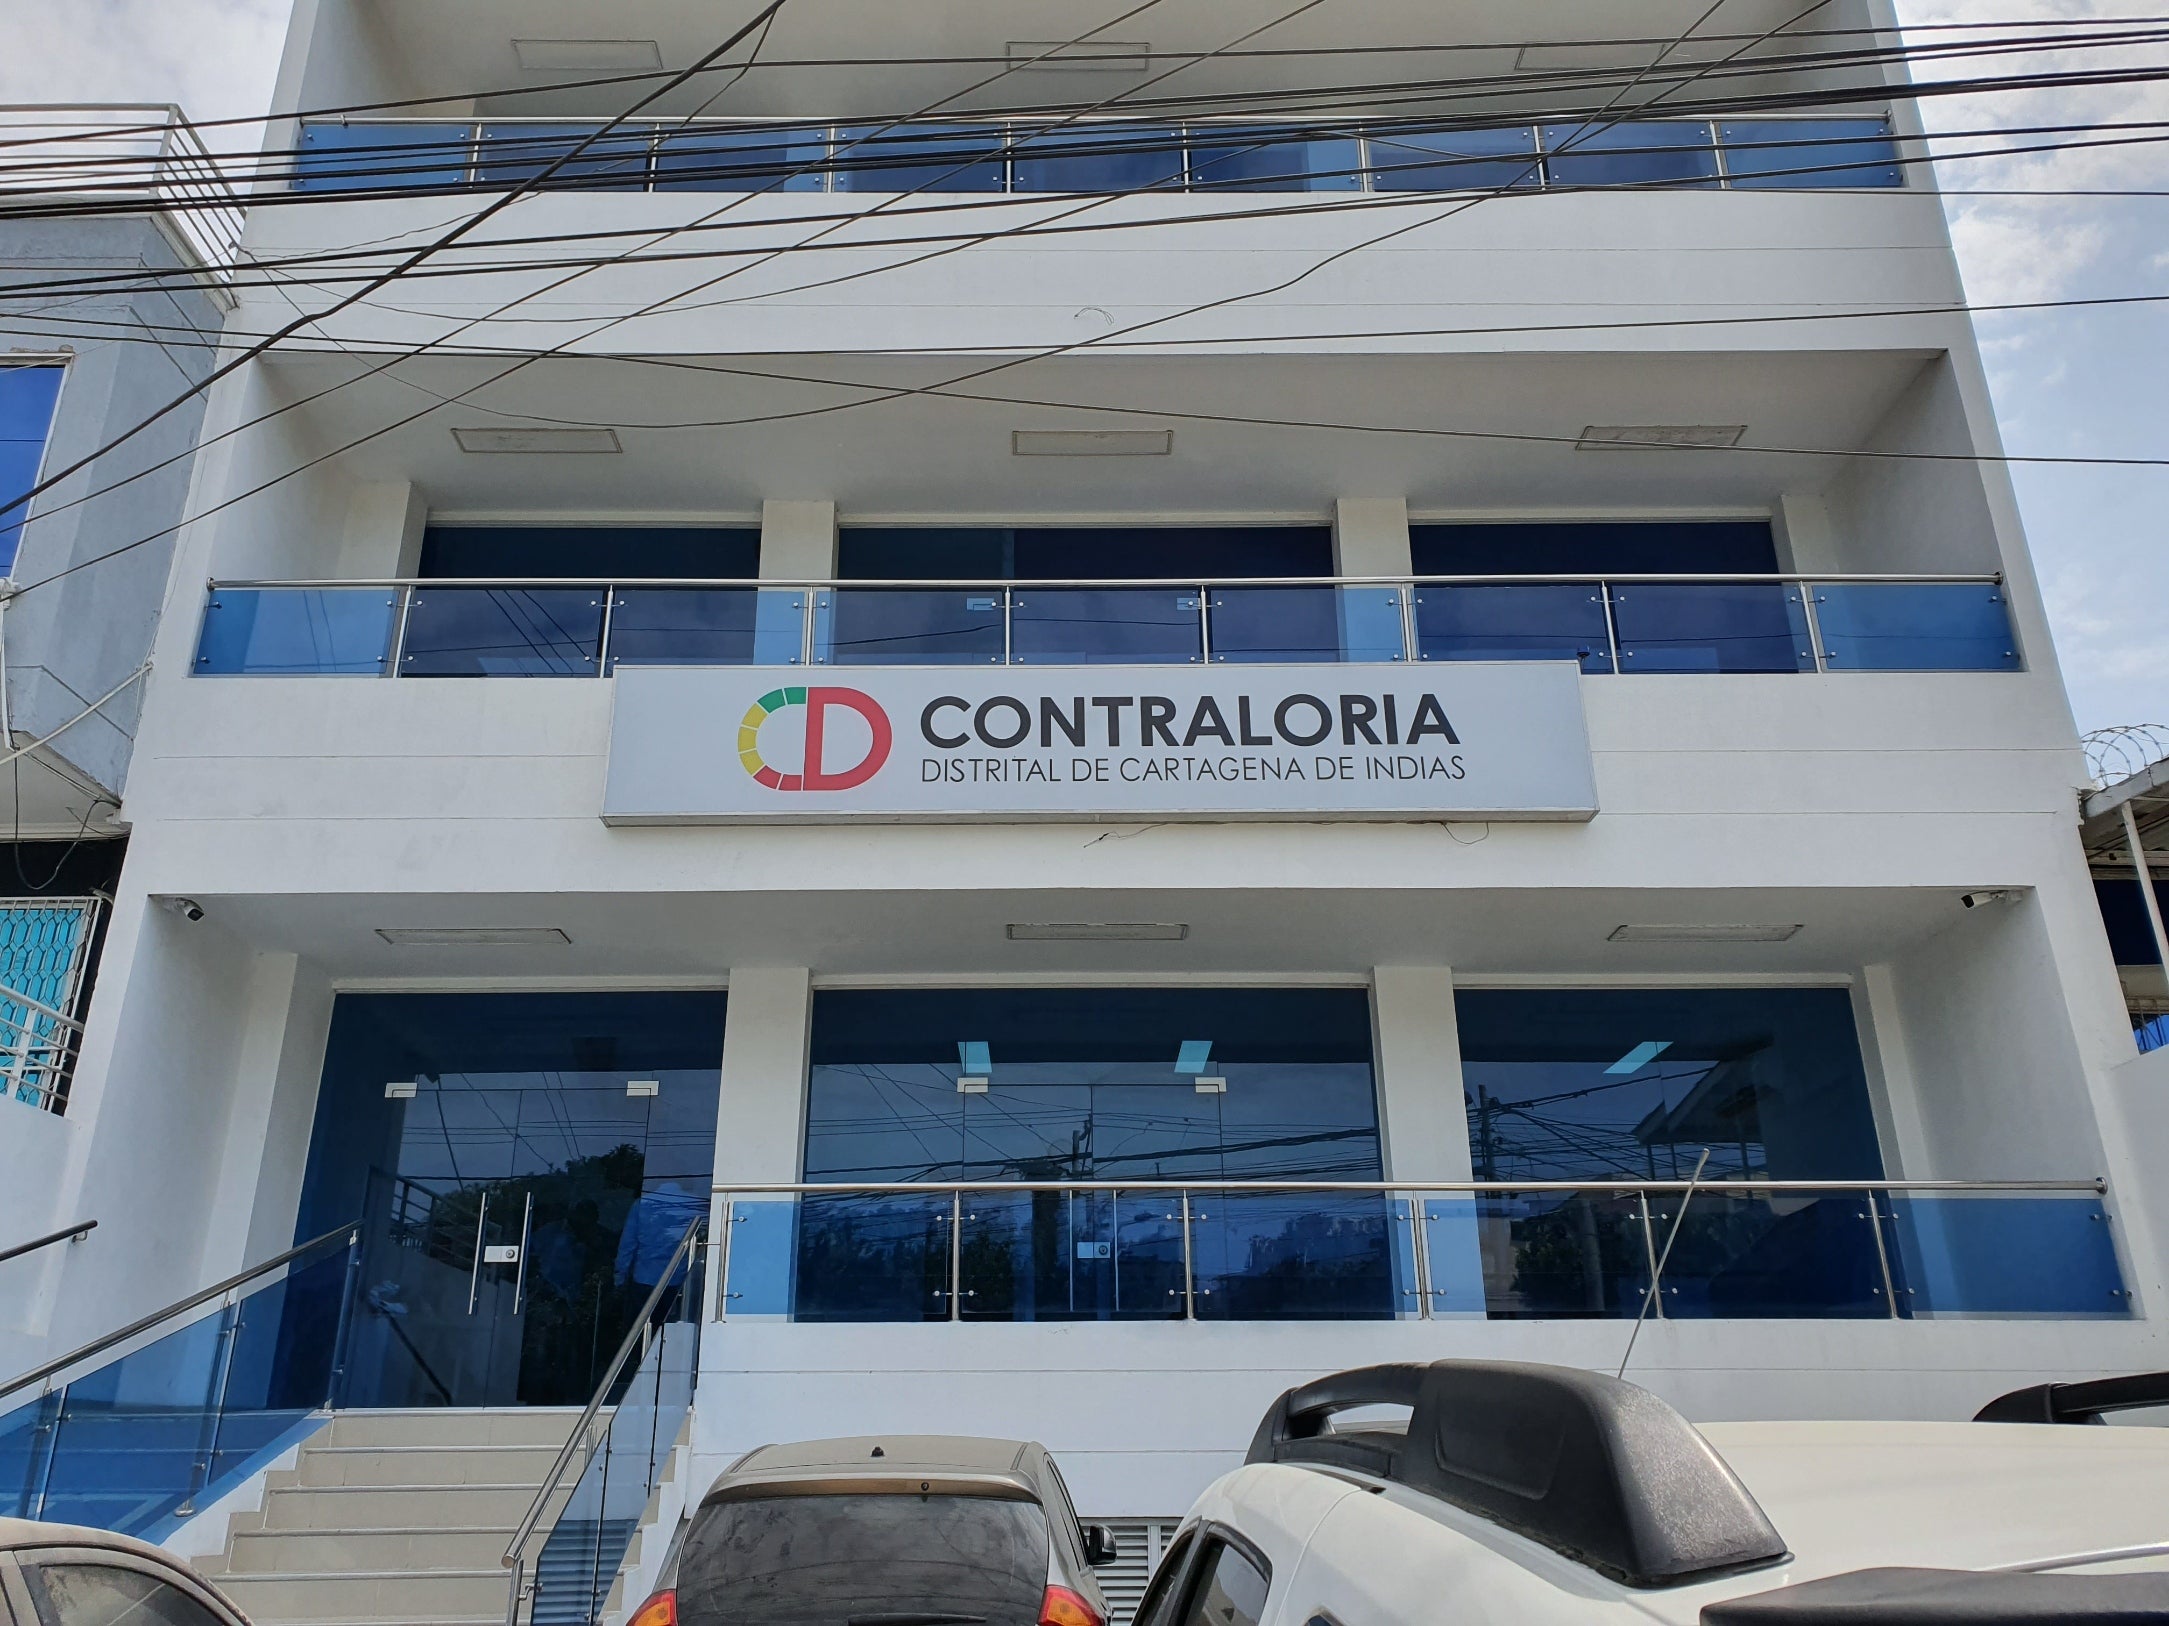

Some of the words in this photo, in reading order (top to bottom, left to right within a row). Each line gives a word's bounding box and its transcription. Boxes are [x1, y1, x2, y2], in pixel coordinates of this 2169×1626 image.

[736, 686, 892, 791] CD
[920, 693, 1461, 749] CONTRALORIA
[921, 757, 1062, 783] DISTRITAL
[1071, 757, 1110, 782] DE
[1119, 756, 1306, 782] CARTAGENA
[1315, 756, 1355, 781] DE
[1365, 755, 1466, 781] INDIAS
